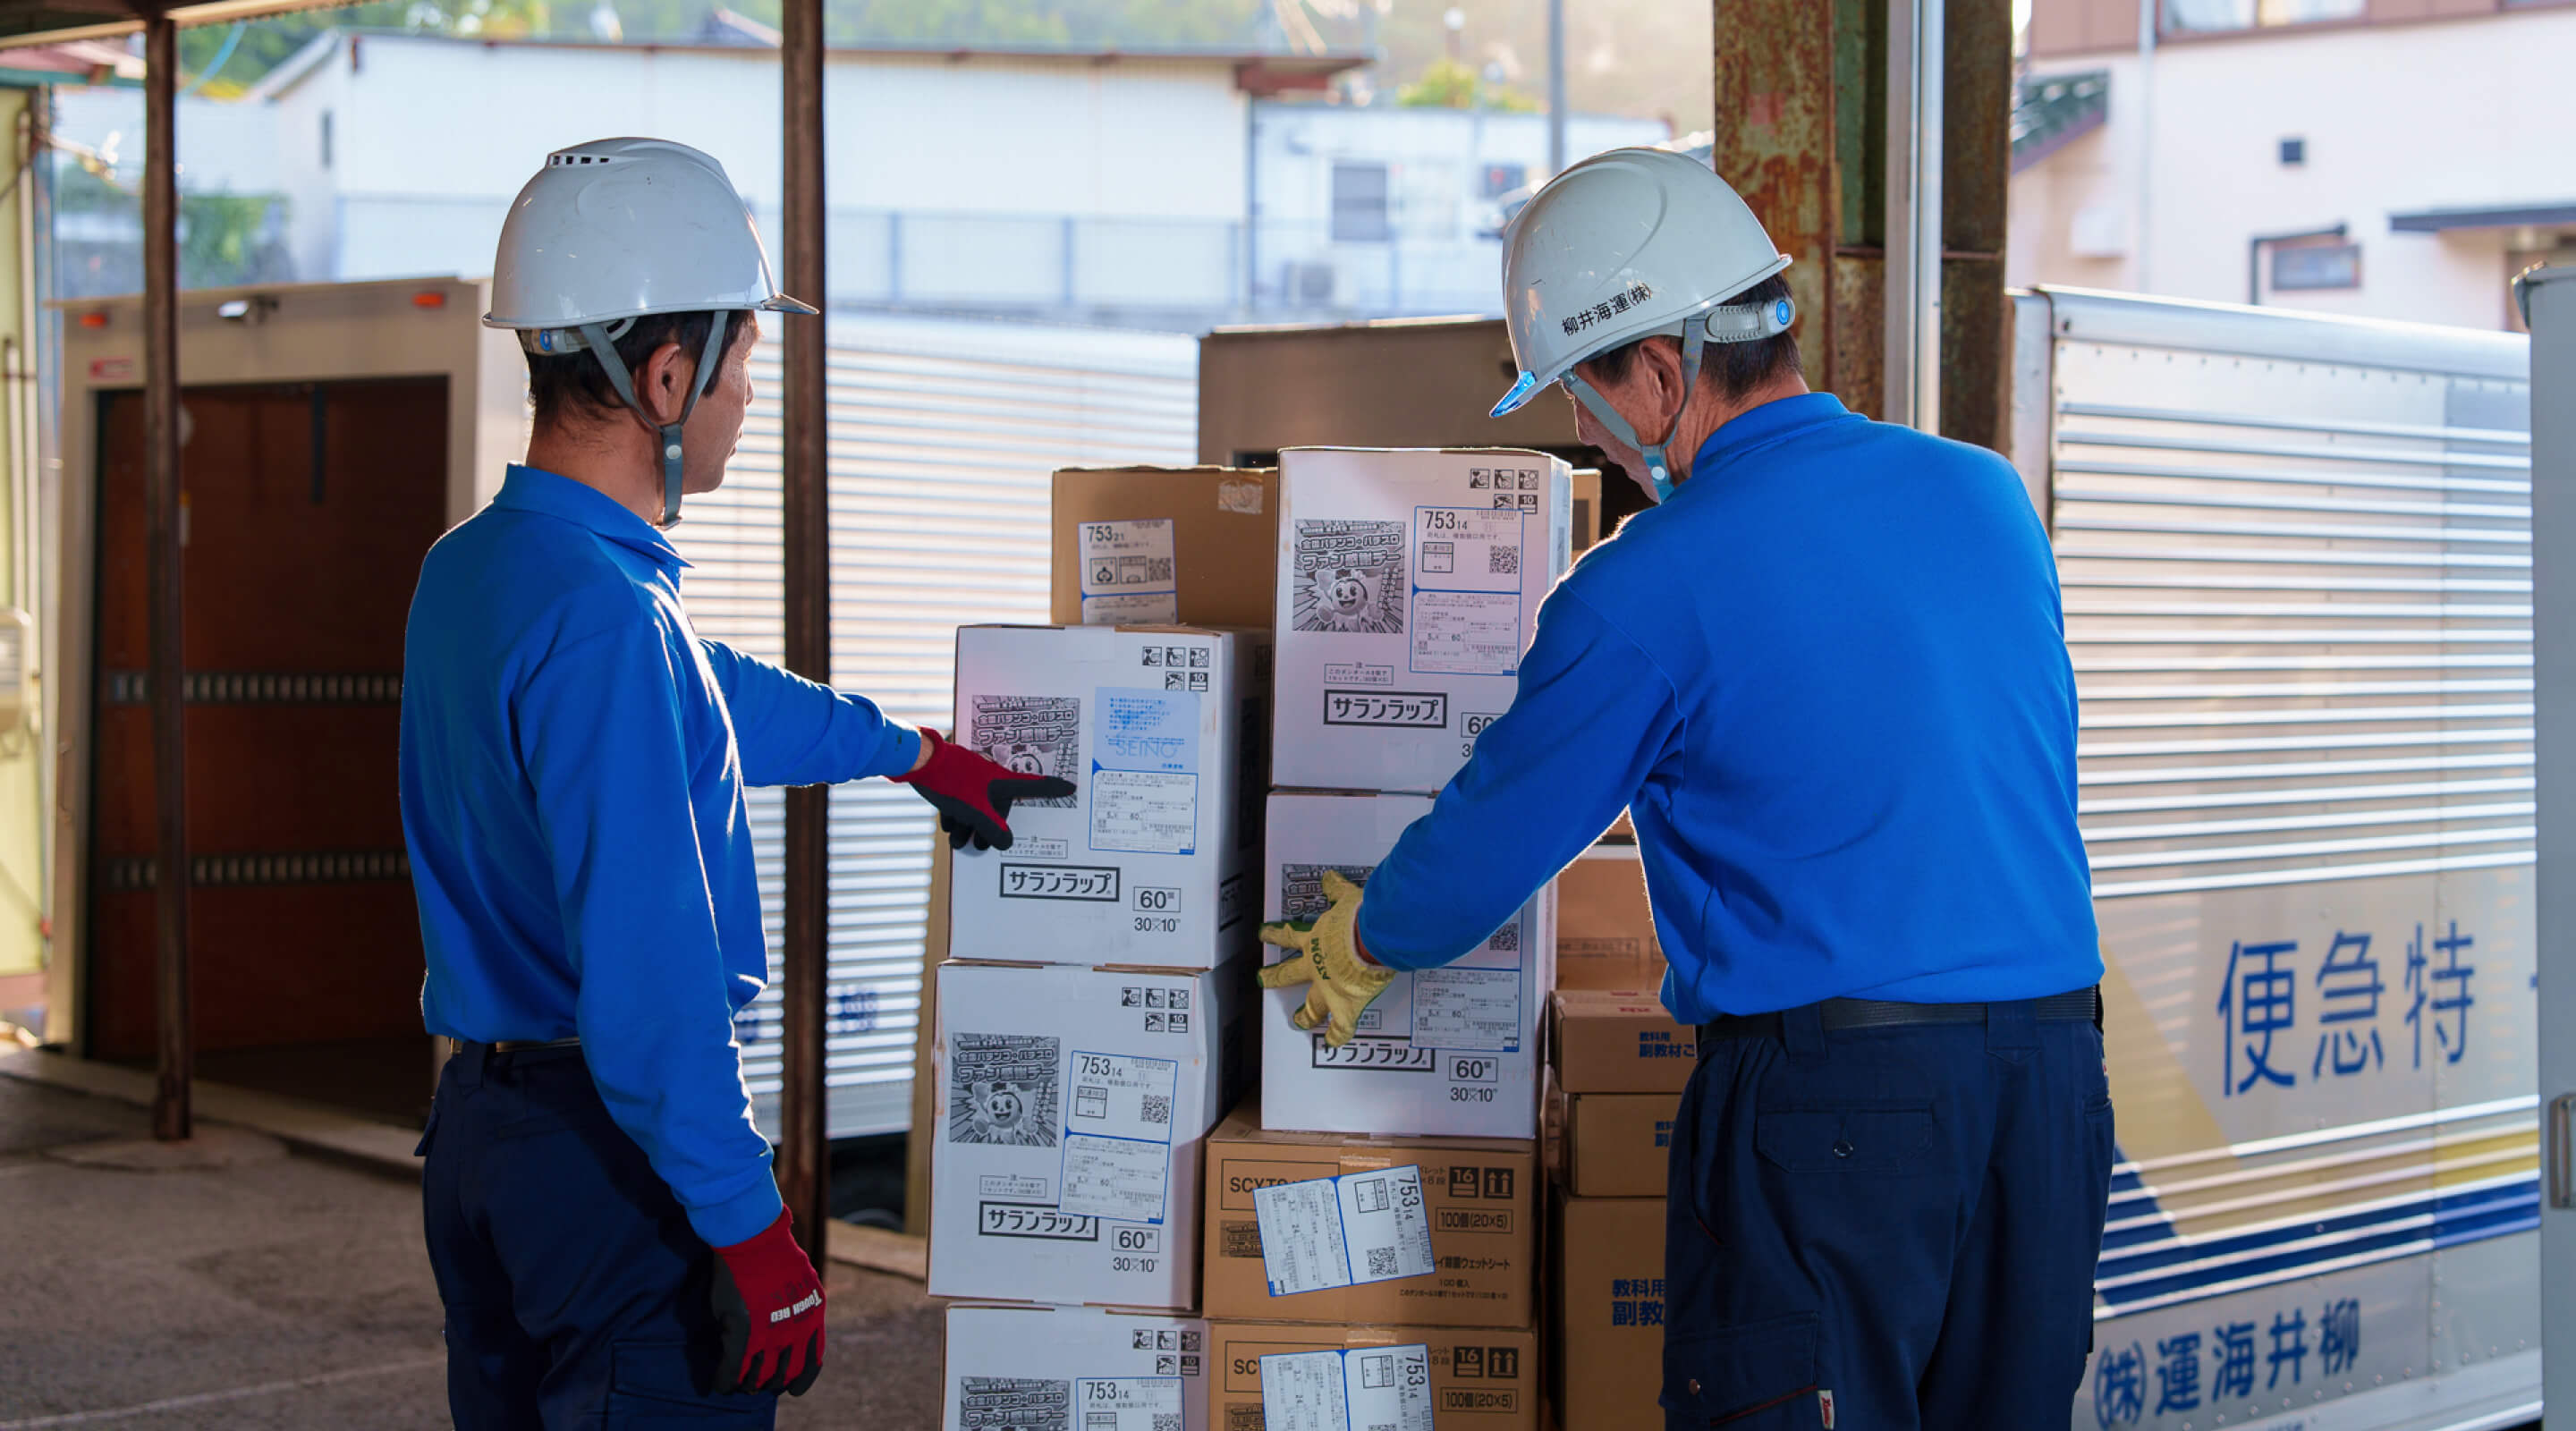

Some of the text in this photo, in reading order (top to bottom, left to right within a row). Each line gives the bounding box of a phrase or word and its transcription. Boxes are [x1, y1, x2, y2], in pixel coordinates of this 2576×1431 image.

[1425, 511, 1455, 529] 753
[1087, 525, 1113, 542] 753
[1081, 1055, 1111, 1076] 753
[1086, 1382, 1116, 1400] 753
